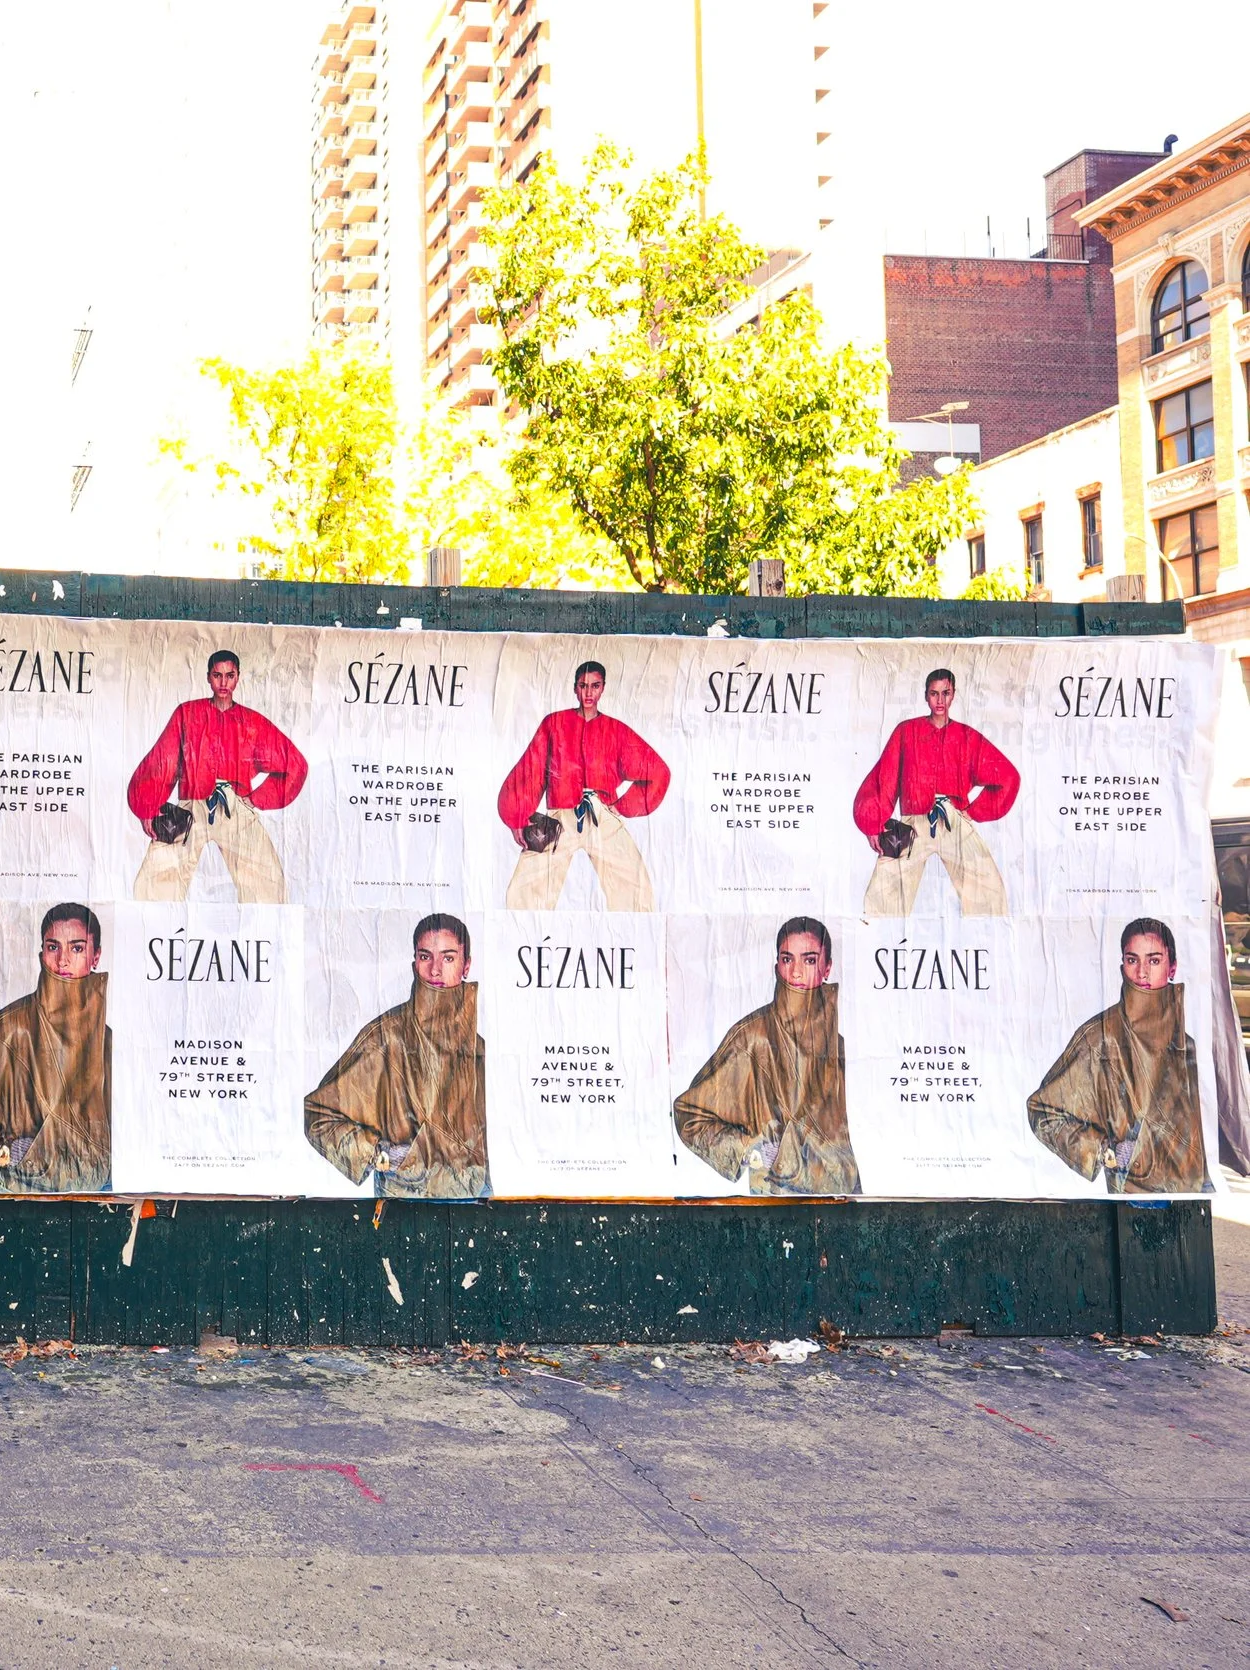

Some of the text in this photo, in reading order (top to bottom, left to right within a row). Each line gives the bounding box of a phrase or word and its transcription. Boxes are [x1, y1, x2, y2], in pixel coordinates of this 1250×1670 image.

[344, 650, 468, 706] SÉZANE
[705, 662, 825, 714] SÉZANE
[1055, 667, 1175, 718] SÉZANE
[13, 754, 82, 763] PARISIAN
[352, 764, 453, 775] THE PARISIAN
[713, 773, 810, 782] THE PARISIAN
[1062, 776, 1159, 785] THE PARISIAN
[363, 781, 443, 791] WARDROBE
[0, 786, 28, 795] THE
[36, 787, 84, 796] UPPER
[723, 789, 800, 797] WARDROBE
[1073, 792, 1149, 800] WARDROBE
[349, 796, 456, 807] ON THE UPPER
[34, 803, 68, 812] SIDE
[711, 804, 814, 813] ON THE UPPER
[1059, 807, 1161, 816] ON THE UPPER
[365, 812, 440, 823] EAST SIDE
[727, 820, 799, 828] EAST SIDE
[1075, 823, 1146, 831] EAST SIDE
[147, 928, 270, 982] SÉZANE
[517, 936, 635, 989] SÉZANE
[874, 939, 990, 990] SÉZANE
[175, 1040, 242, 1049] MADISON
[545, 1046, 609, 1054] MADISON
[903, 1046, 965, 1054] MADISON
[170, 1056, 246, 1066] AVENUE &
[542, 1062, 614, 1071] AVENUE &
[901, 1062, 970, 1070] AVENUE &
[159, 1072, 256, 1083] 79TH STREET,
[890, 1078, 981, 1086] 79TH STREET,
[532, 1078, 623, 1087] 79TH STREET,
[169, 1090, 247, 1098] NEW YORK
[901, 1094, 975, 1102] NEW YORK
[541, 1095, 615, 1103] NEW YORK
